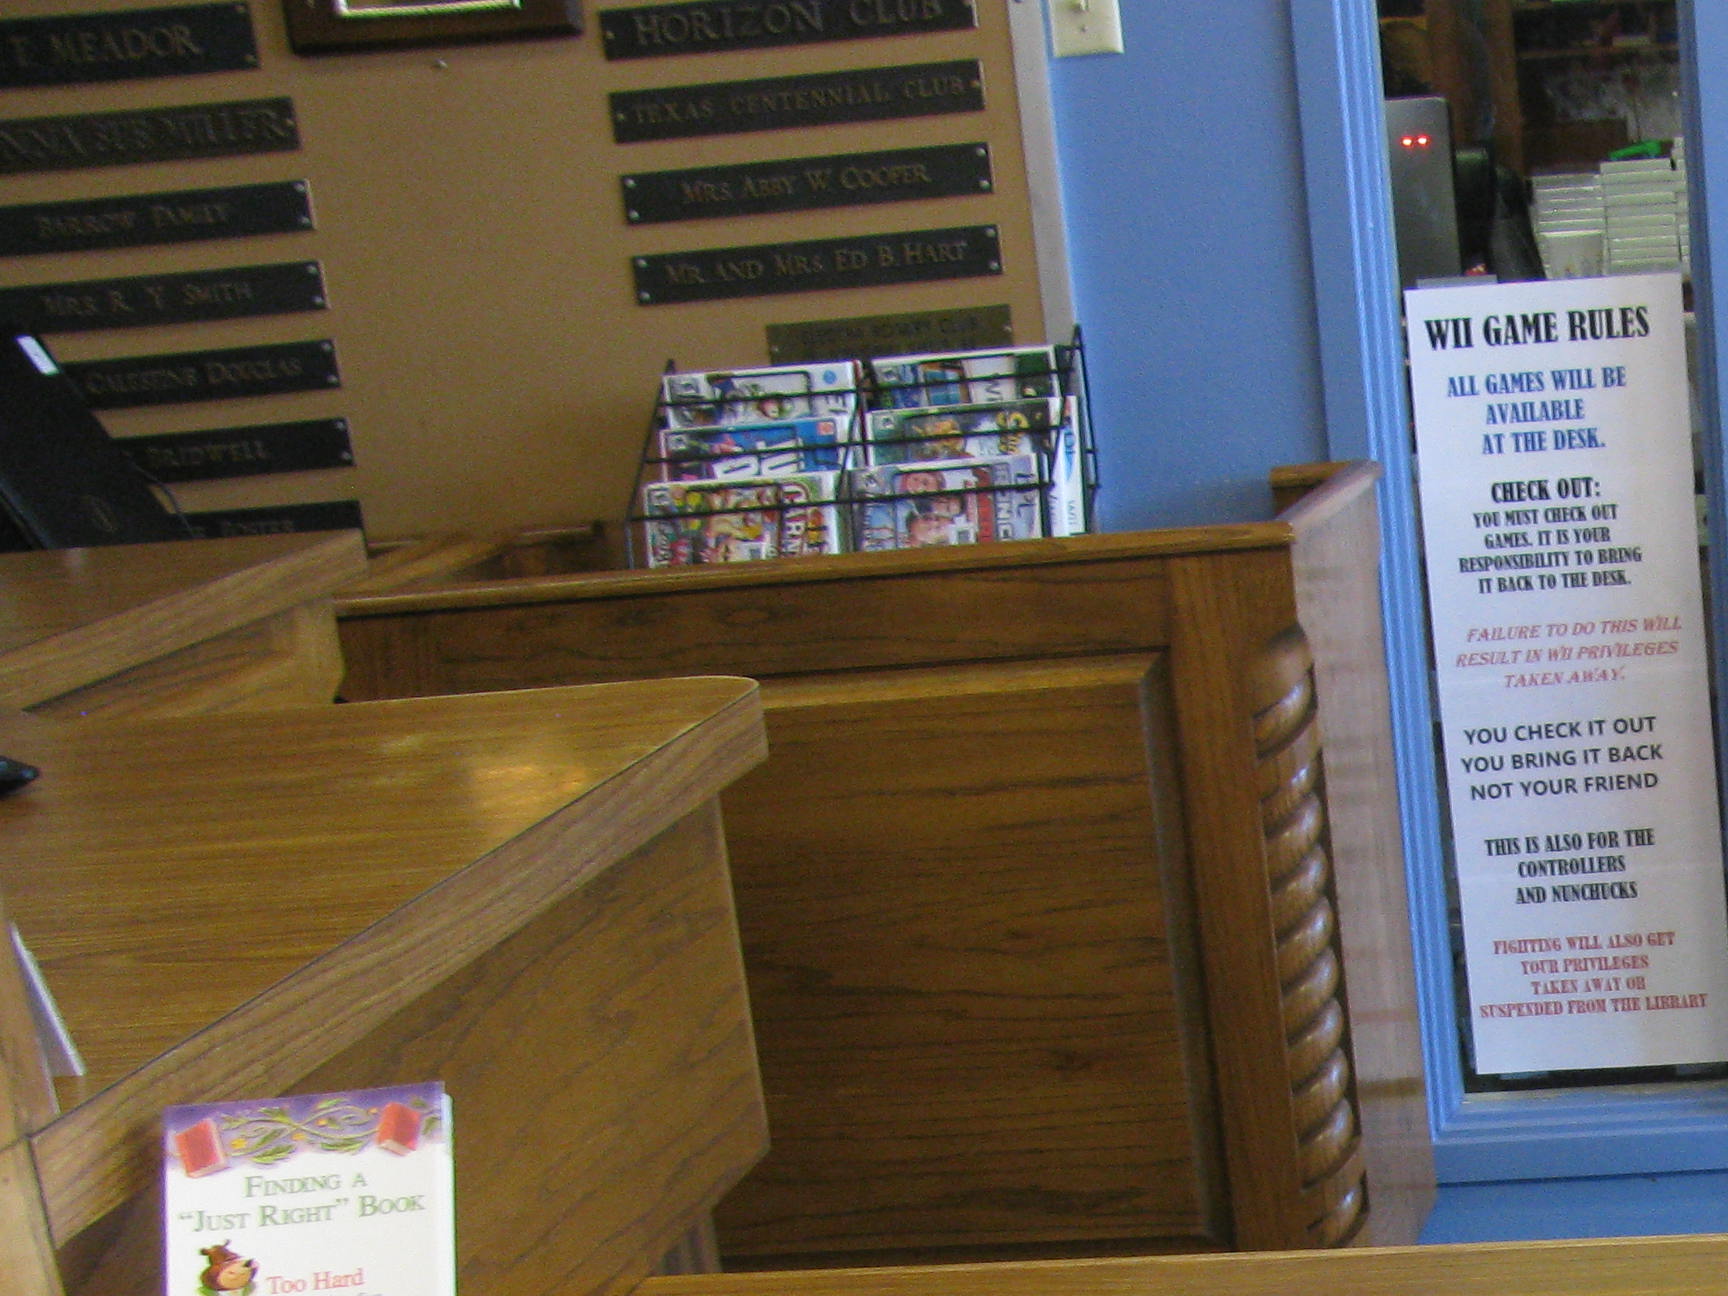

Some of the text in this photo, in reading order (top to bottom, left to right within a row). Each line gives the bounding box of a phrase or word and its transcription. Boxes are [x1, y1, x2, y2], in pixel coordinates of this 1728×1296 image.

[633, 0, 943, 44] HORIZON CLUB
[48, 24, 203, 63] MEADOR
[632, 75, 965, 124] TEXAS CENTENNIAL CLUB
[838, 164, 931, 190] COOPER
[834, 249, 868, 272] ED
[902, 240, 968, 265] HART
[1424, 305, 1649, 350] WII GAME RULES
[1448, 366, 1625, 397] ALL GAMES WILL BE
[1486, 398, 1583, 424] AVAILABLE
[1483, 427, 1605, 454] AT THE DESK.
[1491, 477, 1600, 503] CHECK OUT:
[1473, 503, 1617, 528] YOU MUST CHECK OUT
[1537, 530, 1552, 546] IT
[1555, 529, 1569, 545] IS
[1573, 526, 1610, 543] YOUR
[1458, 547, 1641, 573] RESPONSIBILITY TO BRING
[1478, 569, 1631, 594] IT BACK TO THE DESK.
[1466, 615, 1682, 643] FAILURE TO DO THIS WILL
[1455, 650, 1522, 668] RESULT
[1525, 648, 1543, 663] IN
[1576, 641, 1678, 660] PRIVILEGES
[1504, 671, 1564, 688] TAKEN
[1463, 716, 1656, 745] YOU CHECK IT OUT
[1460, 744, 1662, 773] YOU BRING IT BACK
[1470, 772, 1658, 800] NOT YOUR FRIEND
[1484, 828, 1654, 856] THIS IS ALSO FOR THE
[1517, 855, 1625, 878] CONTROLLERS
[1516, 881, 1638, 904] AND NUNCHUCKS
[1493, 931, 1675, 954] FIGHTING WILL ALSO GET
[1520, 955, 1648, 975] YOUR PRIVILEGES
[1530, 979, 1578, 995] TAKEN
[1584, 977, 1621, 992] AWAY
[1479, 993, 1707, 1018] SUSPENDED FROM THE LIBRARY
[244, 1174, 341, 1198] FINDING
[358, 1194, 425, 1217] BOOK
[265, 1269, 364, 1294] Too Hard
